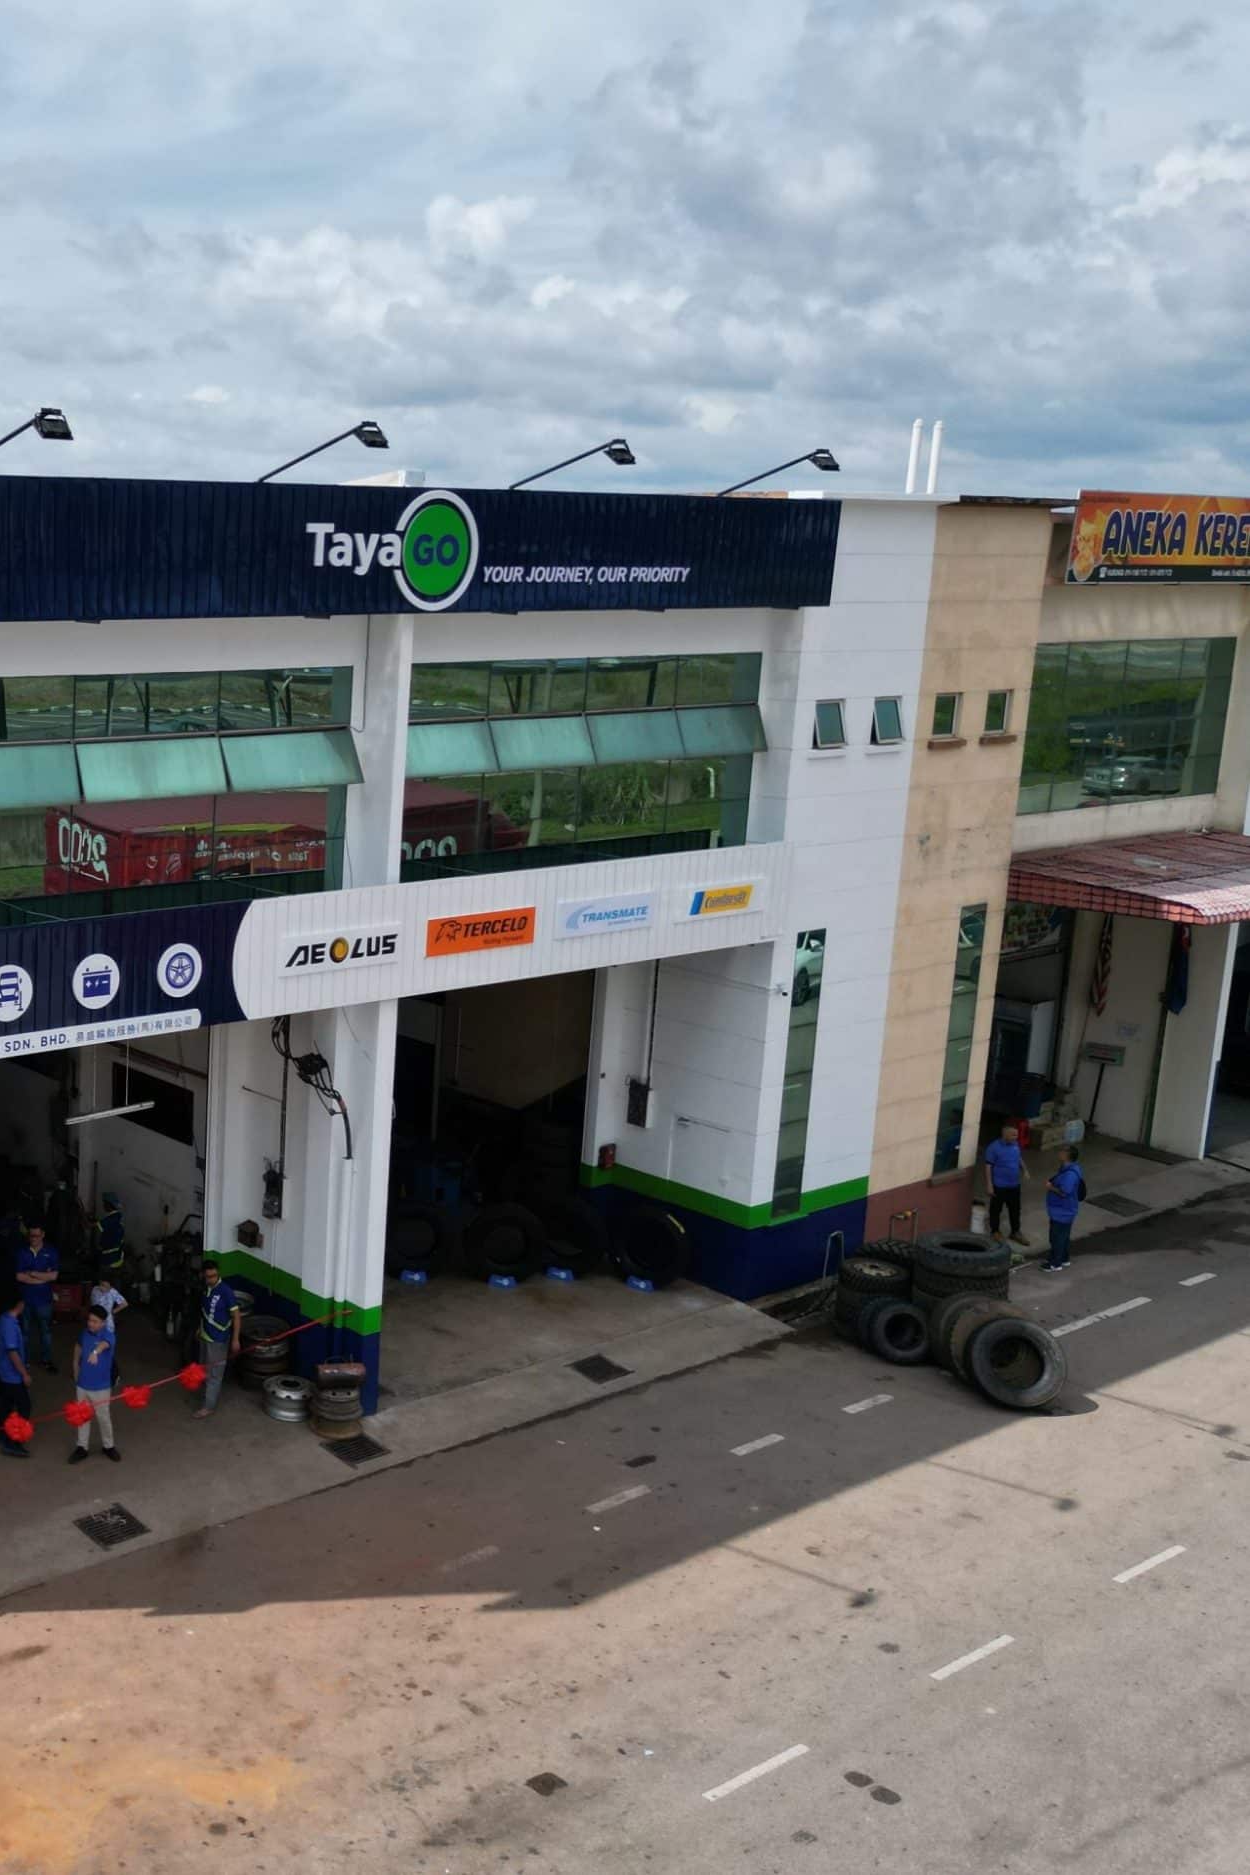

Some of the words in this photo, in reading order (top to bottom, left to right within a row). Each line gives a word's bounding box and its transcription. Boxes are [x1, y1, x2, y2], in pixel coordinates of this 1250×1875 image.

[1101, 510, 1187, 556] ANEKA
[1194, 513, 1250, 557] KERE
[483, 566, 523, 583] YOUR
[526, 566, 594, 585] JOURNEY,
[597, 566, 627, 583] OUR
[629, 566, 690, 583] PRIORITY
[582, 905, 648, 923] TRANSMATE
[463, 916, 528, 938] TERCELO
[285, 933, 398, 968] AEOLUS
[4, 1038, 35, 1053] SDN.
[40, 1032, 70, 1047] BHD.
